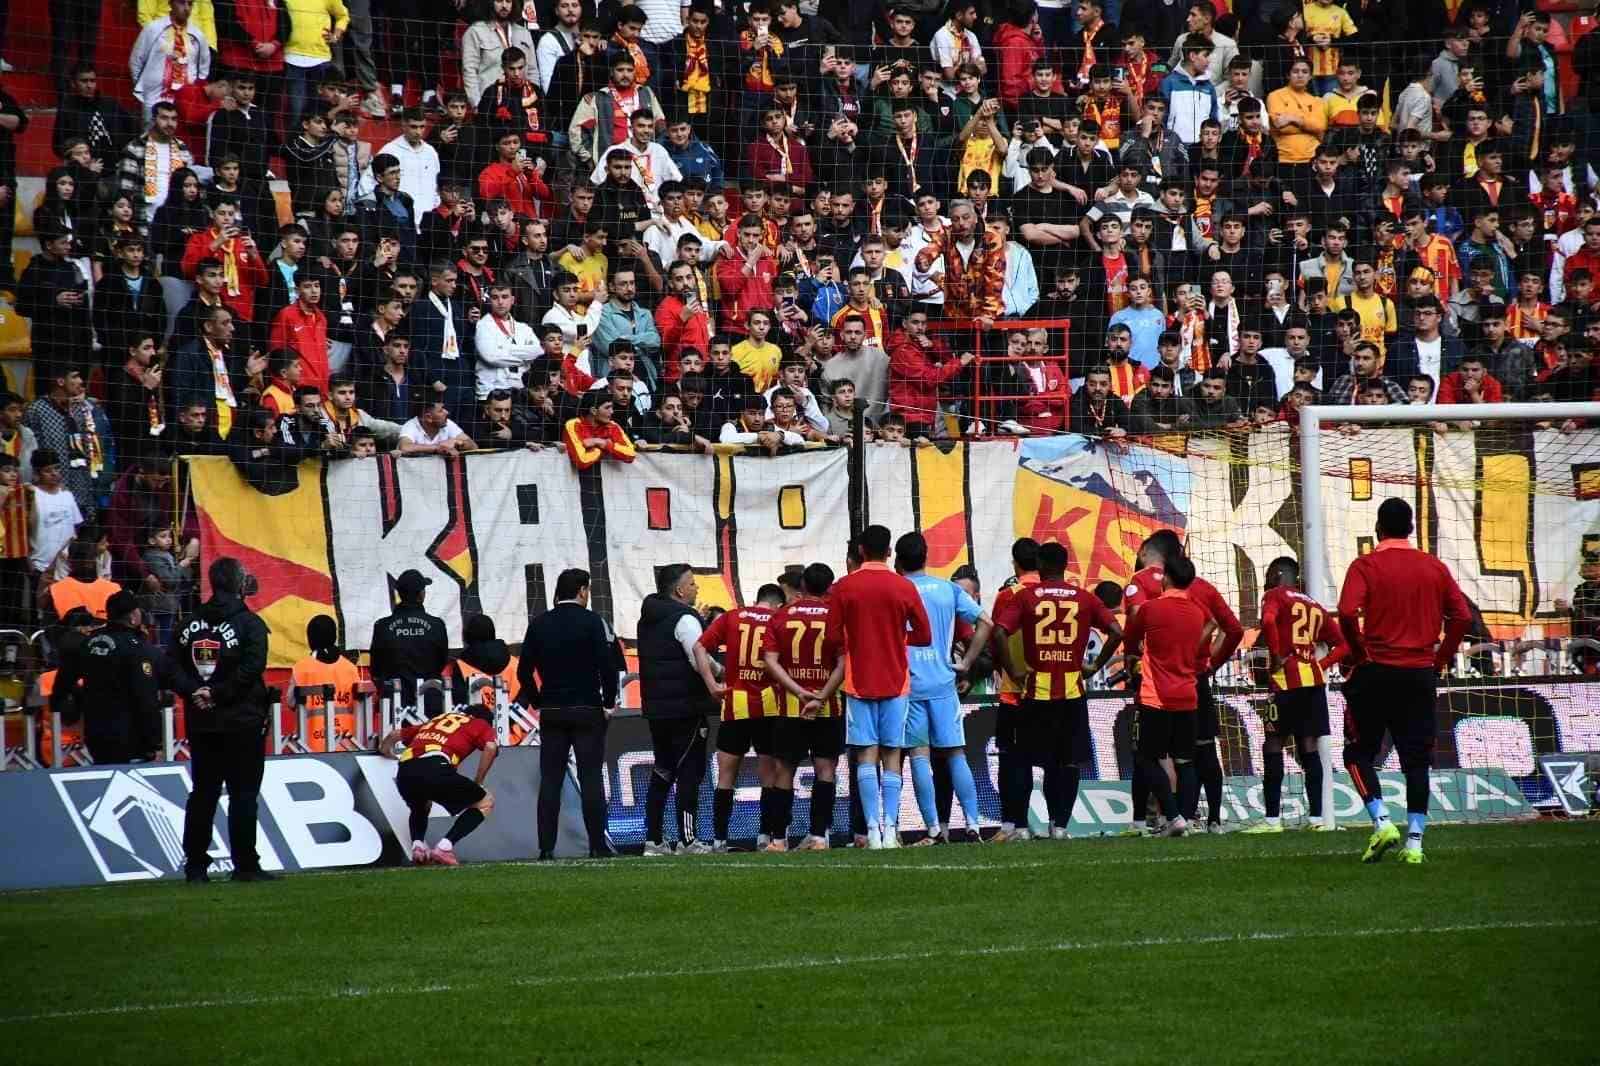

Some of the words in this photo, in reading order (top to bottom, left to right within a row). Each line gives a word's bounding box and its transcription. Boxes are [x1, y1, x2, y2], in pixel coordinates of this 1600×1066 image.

[786, 620, 827, 664] 77
[1035, 601, 1079, 645] 23
[1291, 601, 1323, 645] 20
[739, 669, 764, 681] ERAY
[1039, 650, 1074, 662] CAROLE
